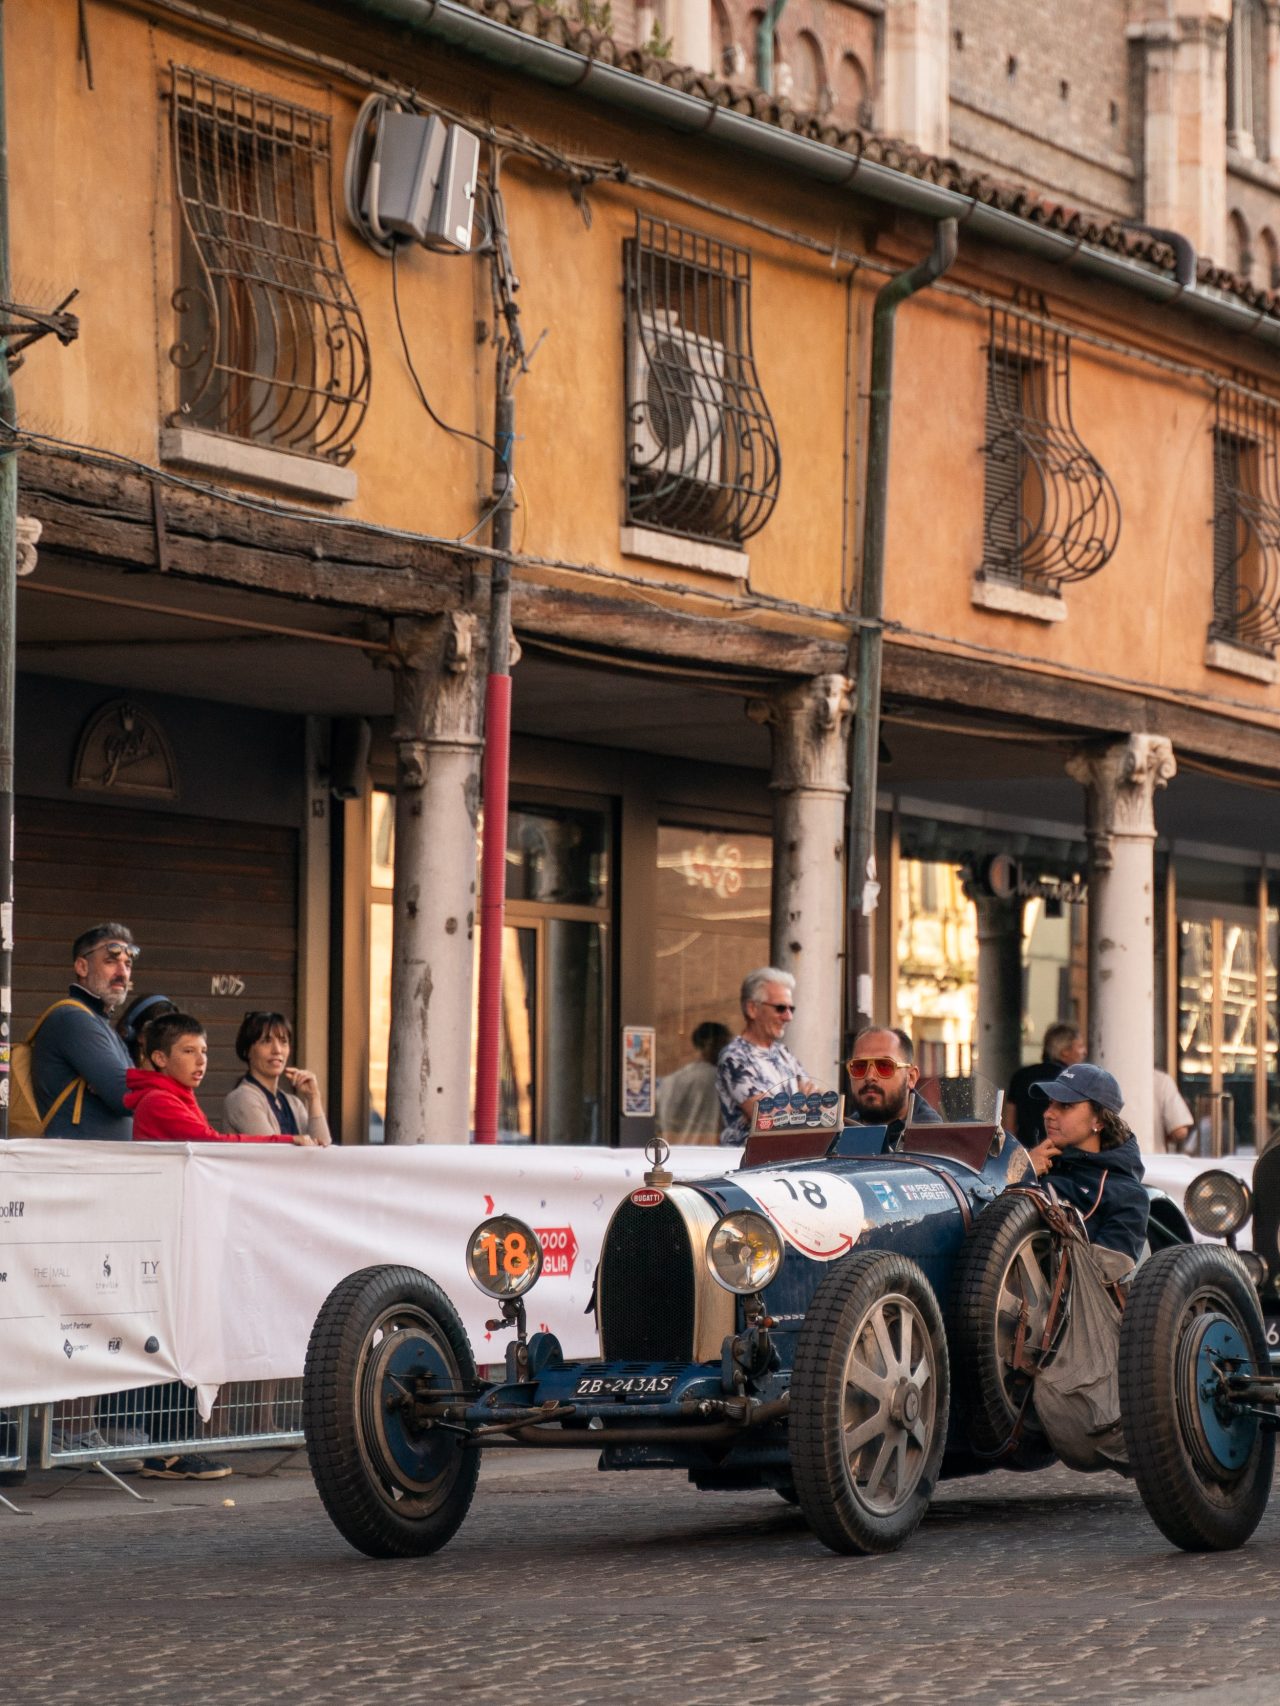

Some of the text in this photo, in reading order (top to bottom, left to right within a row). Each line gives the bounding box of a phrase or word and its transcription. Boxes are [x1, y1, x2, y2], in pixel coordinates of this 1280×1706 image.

[633, 1194, 660, 1202] BUGATTI
[773, 1179, 828, 1210] 18
[537, 1232, 568, 1250] 000
[481, 1231, 529, 1277] 18
[542, 1254, 569, 1274] GLIA
